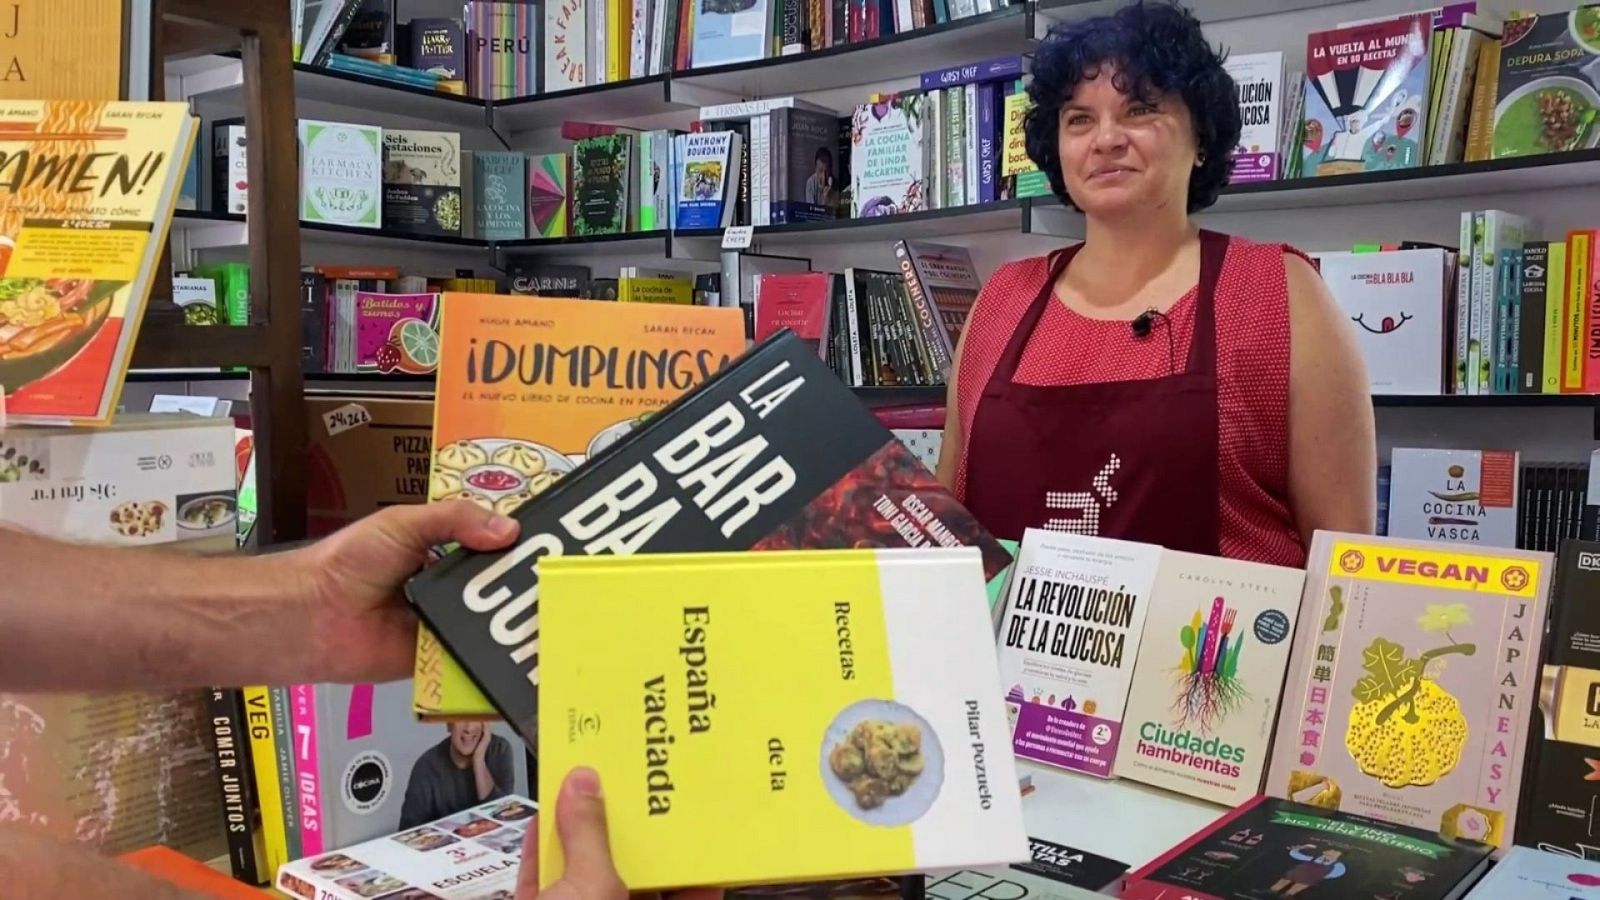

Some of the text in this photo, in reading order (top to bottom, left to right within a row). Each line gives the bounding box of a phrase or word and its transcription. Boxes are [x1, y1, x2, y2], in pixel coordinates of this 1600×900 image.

[5, 4, 20, 38] J
[423, 33, 451, 46] HARRY
[477, 36, 531, 54] PERÚ
[1313, 39, 1381, 59] LA VUELTA AL
[421, 44, 454, 56] POTTER
[1337, 55, 1348, 66] EN
[1363, 48, 1397, 62] RECETAS
[1507, 48, 1585, 68] DEPURA SOPA
[5, 57, 27, 82] A
[385, 134, 408, 145] Seis
[386, 143, 443, 154] estaciones
[688, 135, 727, 147] ANTHONY
[864, 132, 911, 146] LA COCINA
[687, 145, 726, 157] BOURDAIN
[867, 143, 907, 157] FAMILIAR
[867, 154, 907, 168] DE LINDA
[312, 168, 373, 180] KITCHEN
[864, 165, 911, 179] McCARTNEY
[1373, 271, 1414, 285] BLA BLA BLA
[642, 286, 662, 294] cocina
[901, 259, 932, 328] COCINERO
[362, 297, 424, 312] Batidos y
[362, 308, 400, 318] zumos
[515, 318, 556, 329] AMANO
[739, 360, 805, 420] LA
[576, 395, 614, 405] COCINA
[619, 397, 634, 406] EN
[652, 400, 798, 539] BAR
[395, 477, 429, 495] LLEV
[1446, 480, 1466, 491] LA
[560, 461, 682, 557] BA
[872, 493, 900, 521] TONI
[901, 493, 934, 526] OSCAR
[1423, 502, 1487, 517] COCINA
[1427, 526, 1480, 541] VASCA
[1024, 565, 1054, 579] JESSIE
[1376, 556, 1490, 584] VEGAN
[1179, 572, 1278, 595] CAROLYN STEEL
[1014, 577, 1137, 630] LA REVOLUCIÓN
[834, 600, 856, 682] Recetas
[1006, 614, 1127, 669] DE LA GLUCOSA
[678, 605, 718, 736] España
[247, 694, 270, 740] VEG
[213, 716, 236, 769] COMER
[644, 673, 676, 818] vaciada
[1140, 721, 1246, 764] Ciudades
[768, 737, 785, 793] de la
[965, 700, 992, 811] Pilar Pozuelo
[1136, 739, 1241, 779] hambrientas
[279, 747, 294, 828] JAMIE OLIVER
[298, 724, 319, 832] 7 IDEAS
[222, 774, 246, 833] JUNTOS
[1284, 817, 1310, 826] NO
[1316, 823, 1358, 835] TIENE
[1361, 833, 1434, 856] MISTERIO
[1354, 825, 1397, 839] VINO
[1030, 850, 1073, 867] TAS
[432, 859, 518, 890] ESCUELA
